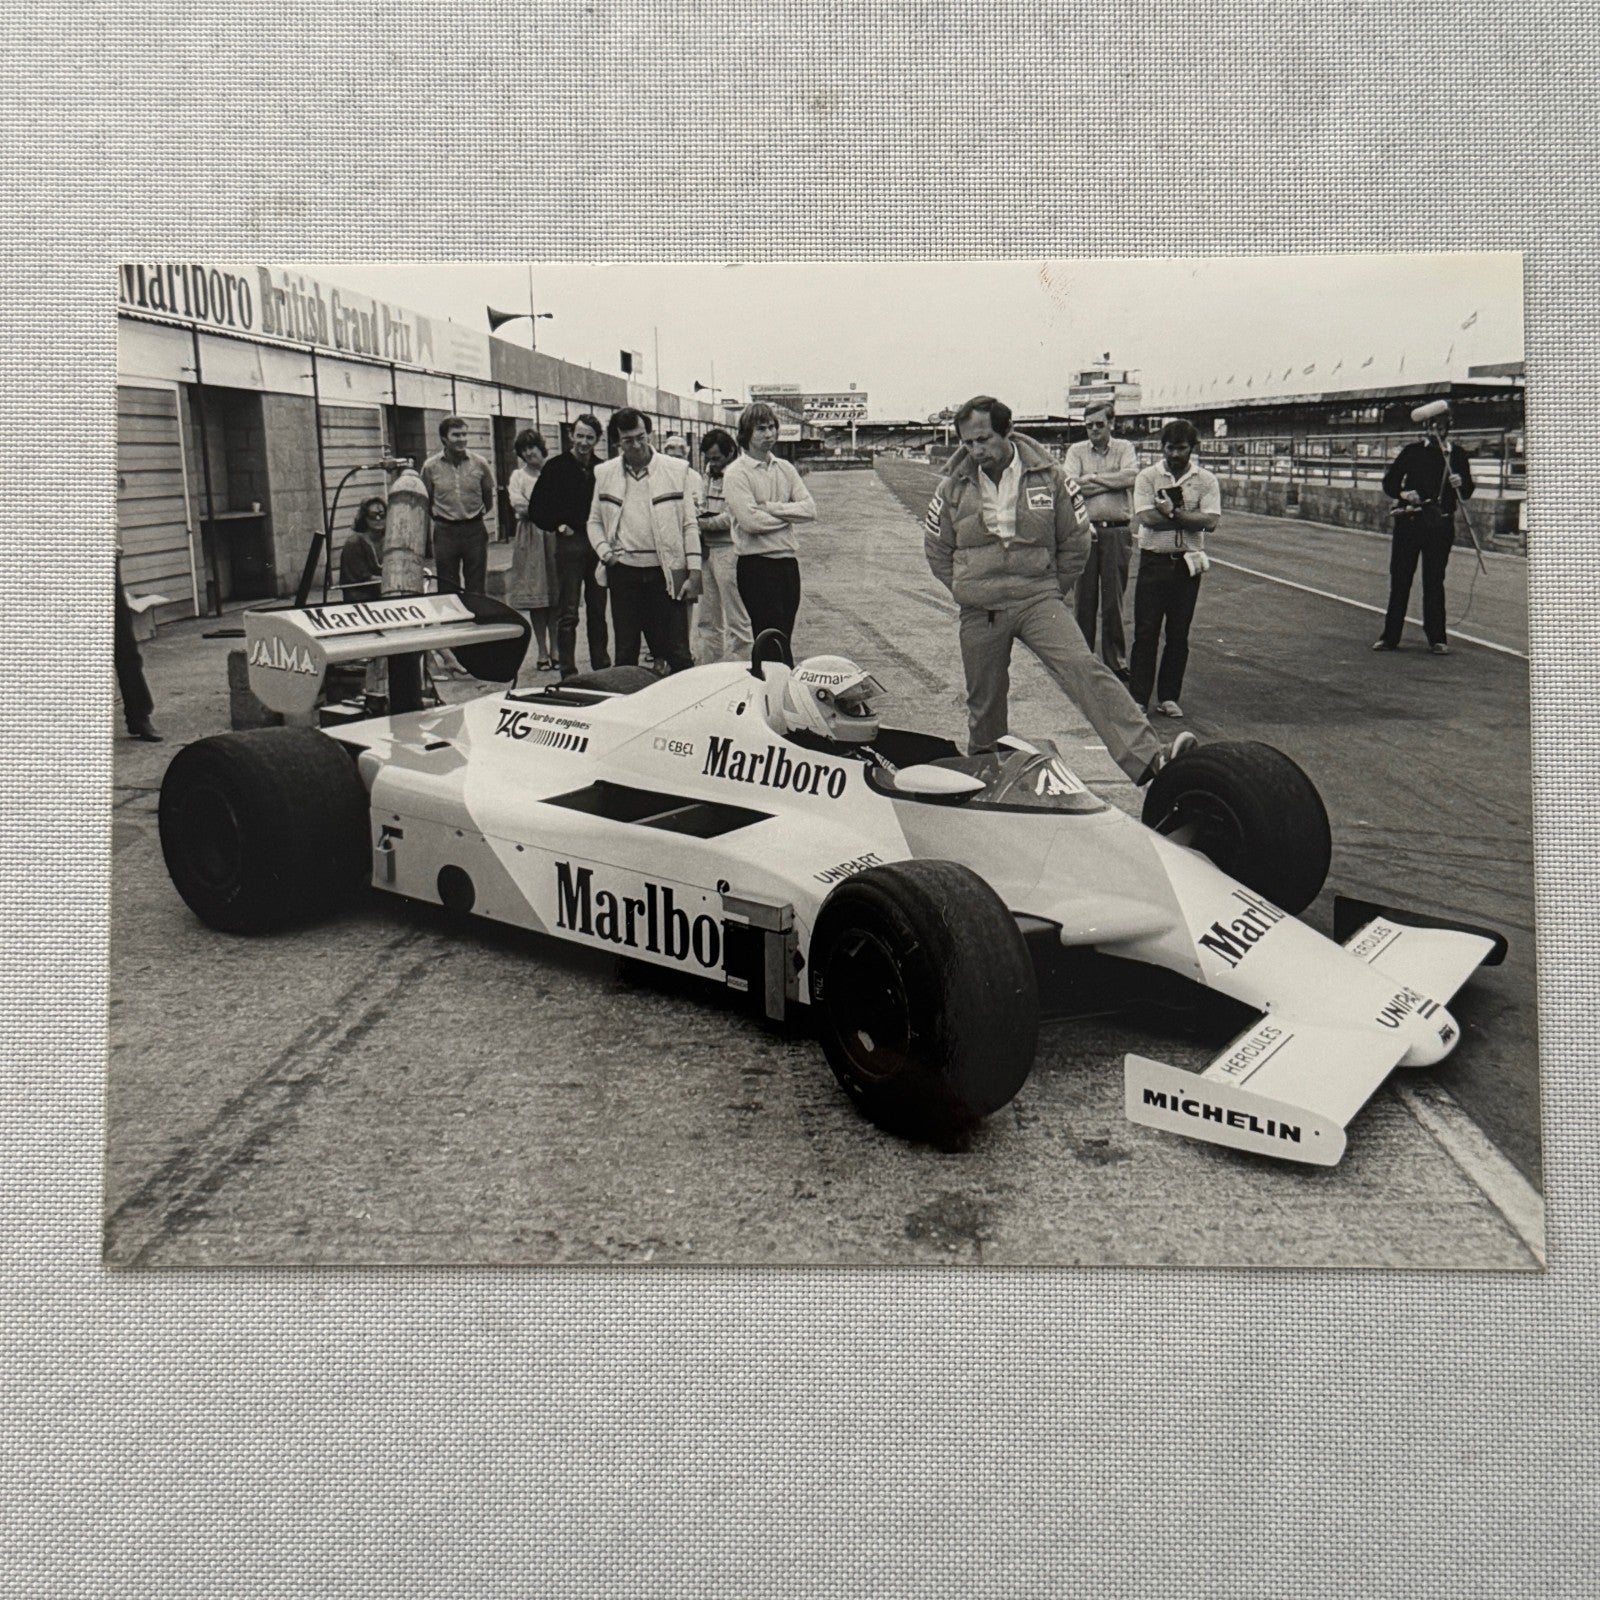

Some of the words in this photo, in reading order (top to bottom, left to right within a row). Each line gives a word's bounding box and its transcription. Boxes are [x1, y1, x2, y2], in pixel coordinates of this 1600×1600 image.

[257, 265, 328, 346] British
[331, 287, 380, 357] Grand
[382, 304, 414, 363] Prix
[816, 411, 865, 420] DUNLOP
[495, 707, 532, 740] TAG
[531, 711, 556, 724] turbo
[554, 717, 592, 731] engines
[702, 736, 847, 799] Marlboro
[813, 852, 884, 885] UNIPART
[554, 861, 726, 970] Marlbo
[1220, 1025, 1282, 1076] HERCULES
[1142, 1088, 1301, 1143] MICHELIN
